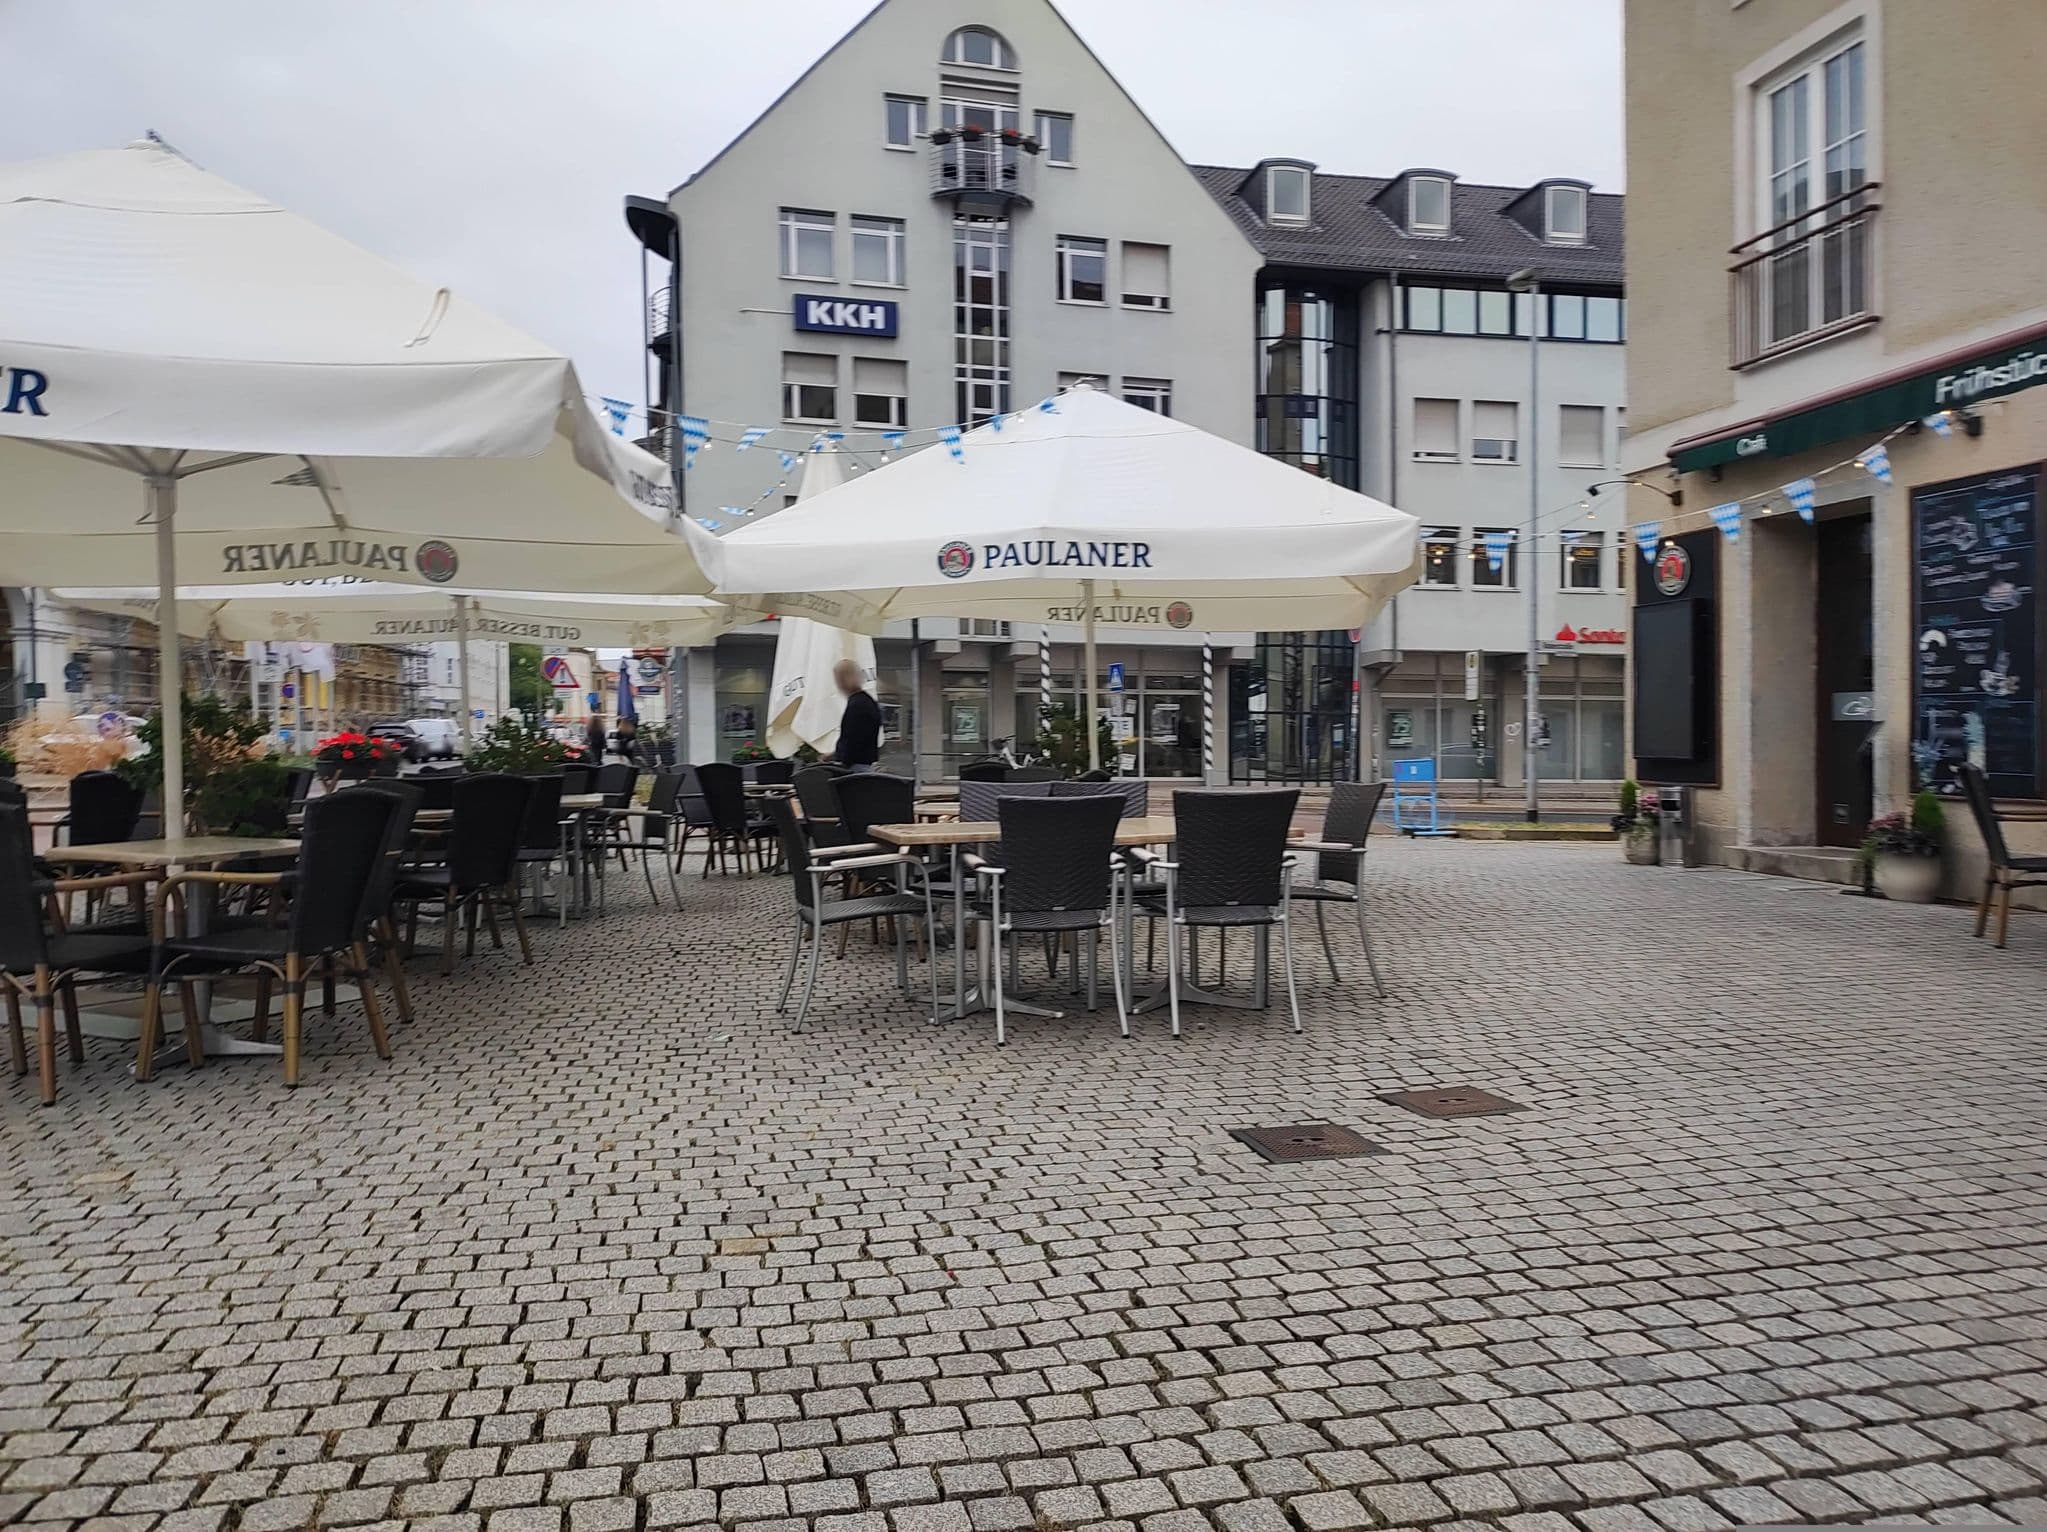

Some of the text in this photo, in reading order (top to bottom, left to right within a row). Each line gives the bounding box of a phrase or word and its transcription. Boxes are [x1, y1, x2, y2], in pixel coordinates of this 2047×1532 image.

[807, 300, 886, 330] KKH
[0, 366, 50, 417] R
[983, 540, 1153, 569] PAULANER
